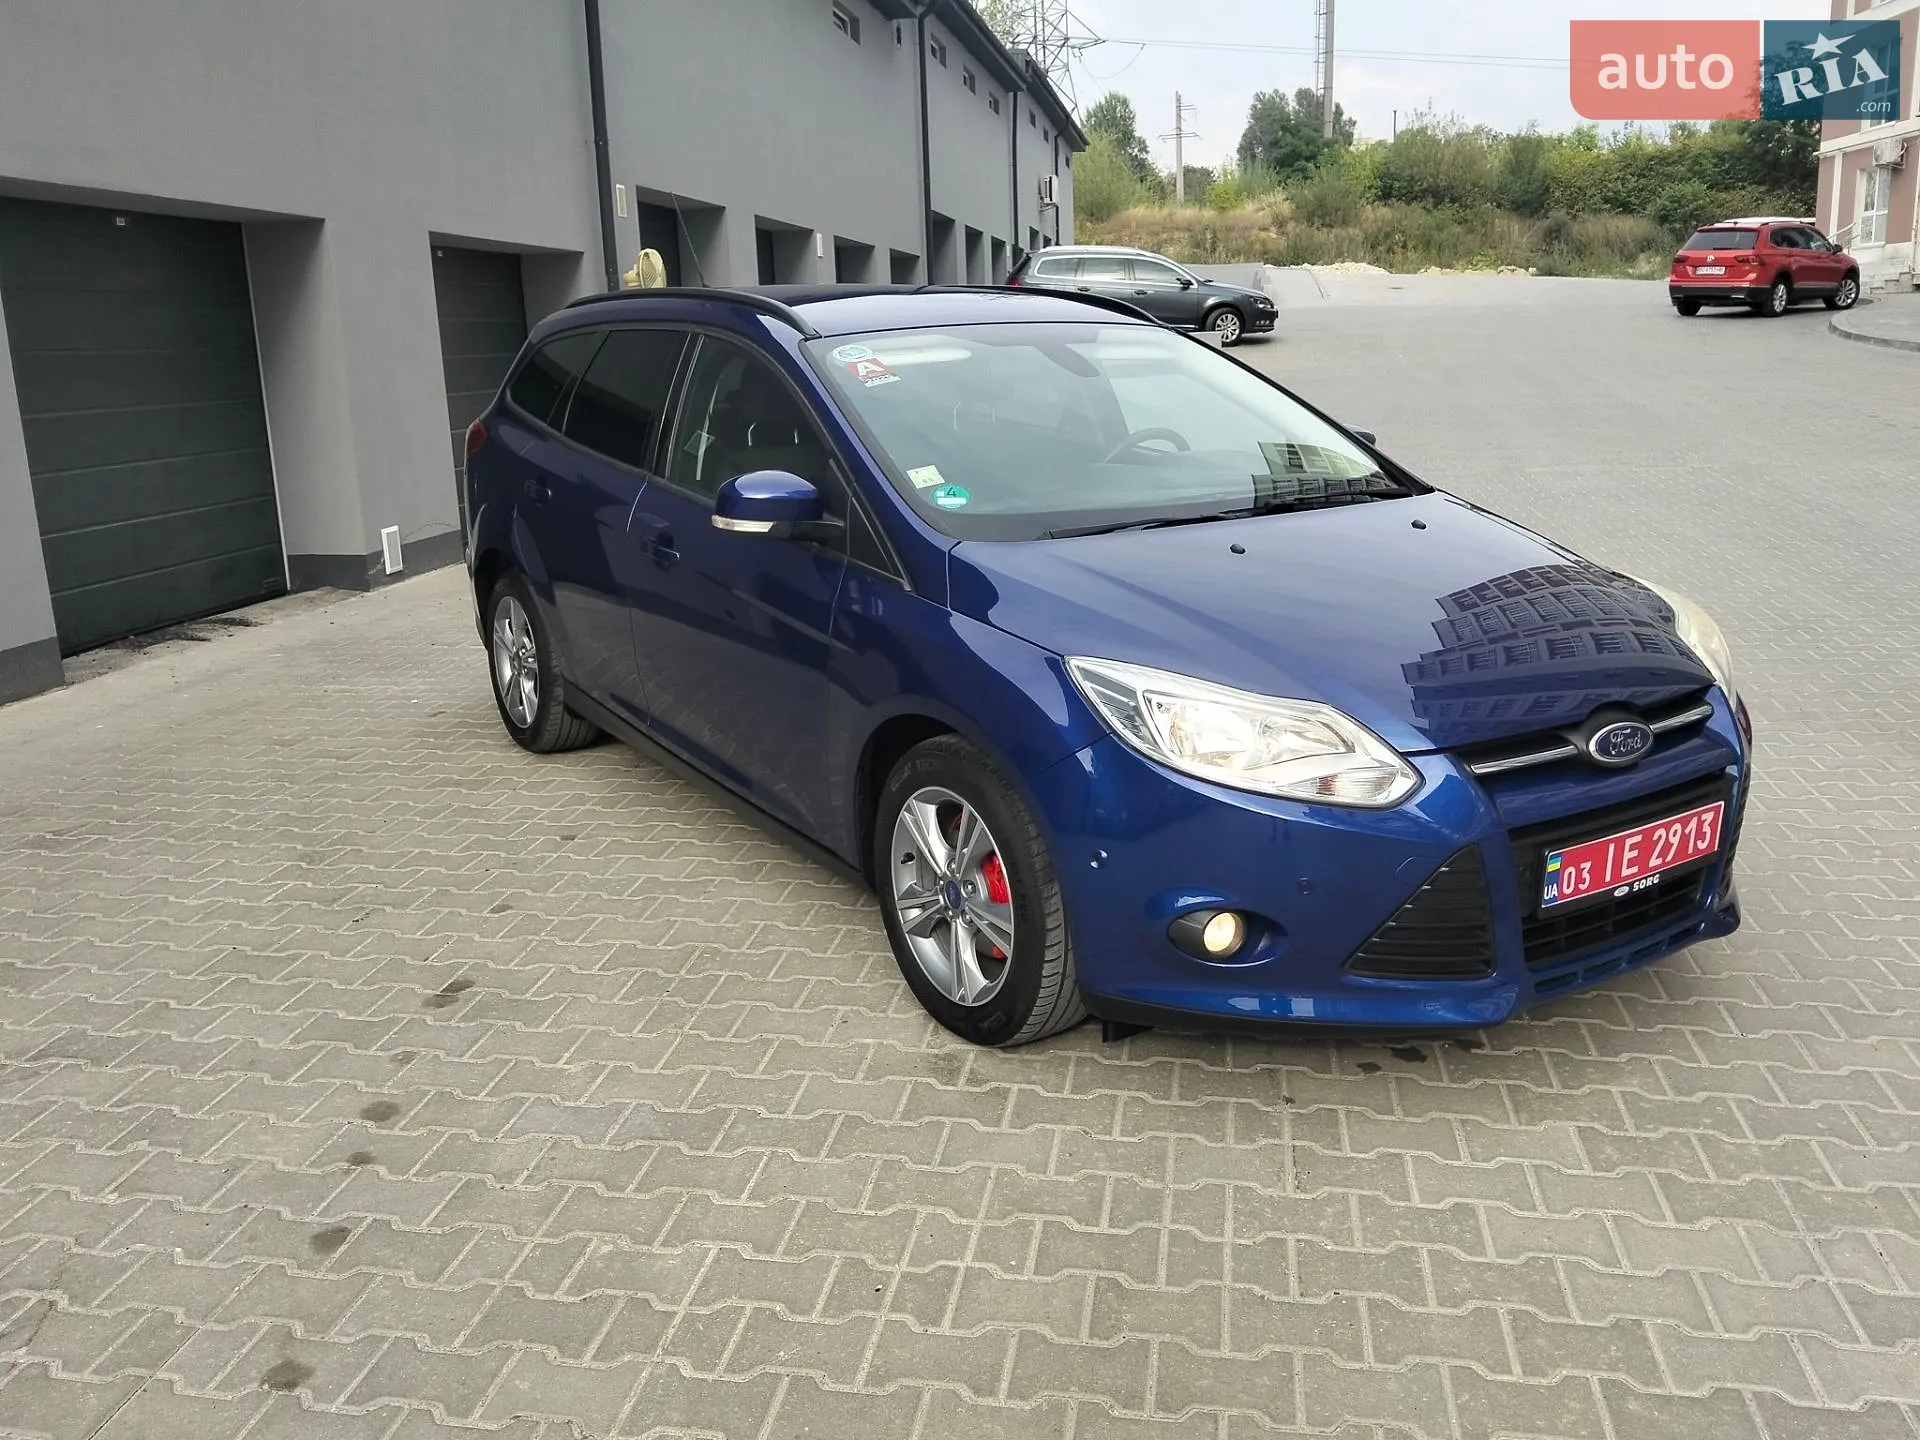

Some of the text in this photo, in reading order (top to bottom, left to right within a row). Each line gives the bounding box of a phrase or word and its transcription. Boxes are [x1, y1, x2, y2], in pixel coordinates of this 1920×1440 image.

[946, 486, 957, 498] 4
[1610, 728, 1642, 755] Ford
[1562, 811, 1714, 895] 03 IE 2913
[1632, 875, 1660, 892] SORG
[1543, 885, 1558, 900] UA
